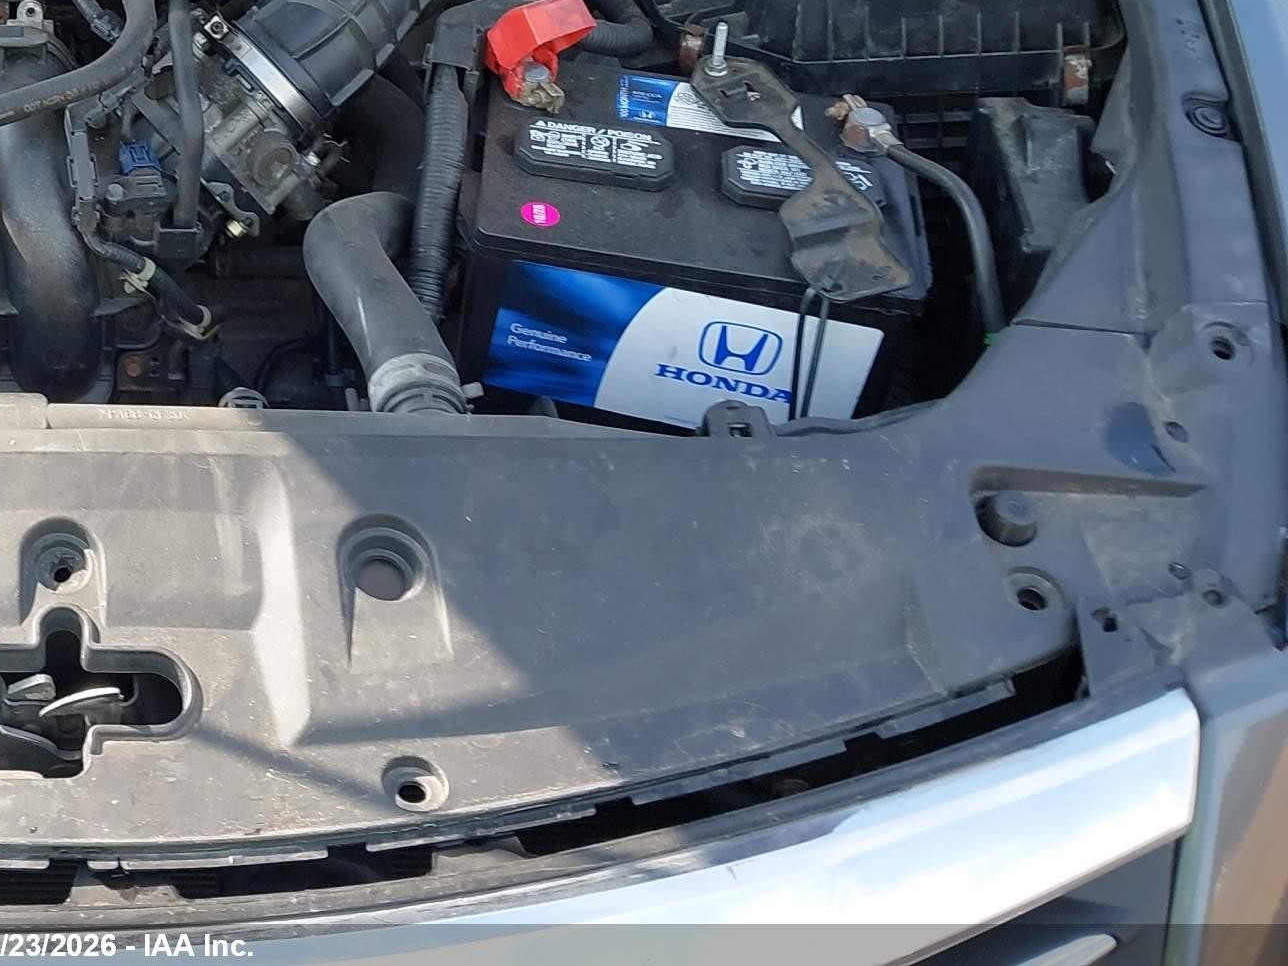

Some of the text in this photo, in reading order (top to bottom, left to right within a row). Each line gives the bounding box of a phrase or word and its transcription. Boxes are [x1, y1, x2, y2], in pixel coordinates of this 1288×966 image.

[547, 120, 597, 135] DANGER
[607, 128, 652, 141] POISON
[510, 323, 568, 344] Genuine
[507, 335, 592, 362] Performance
[655, 363, 793, 404] HONDA
